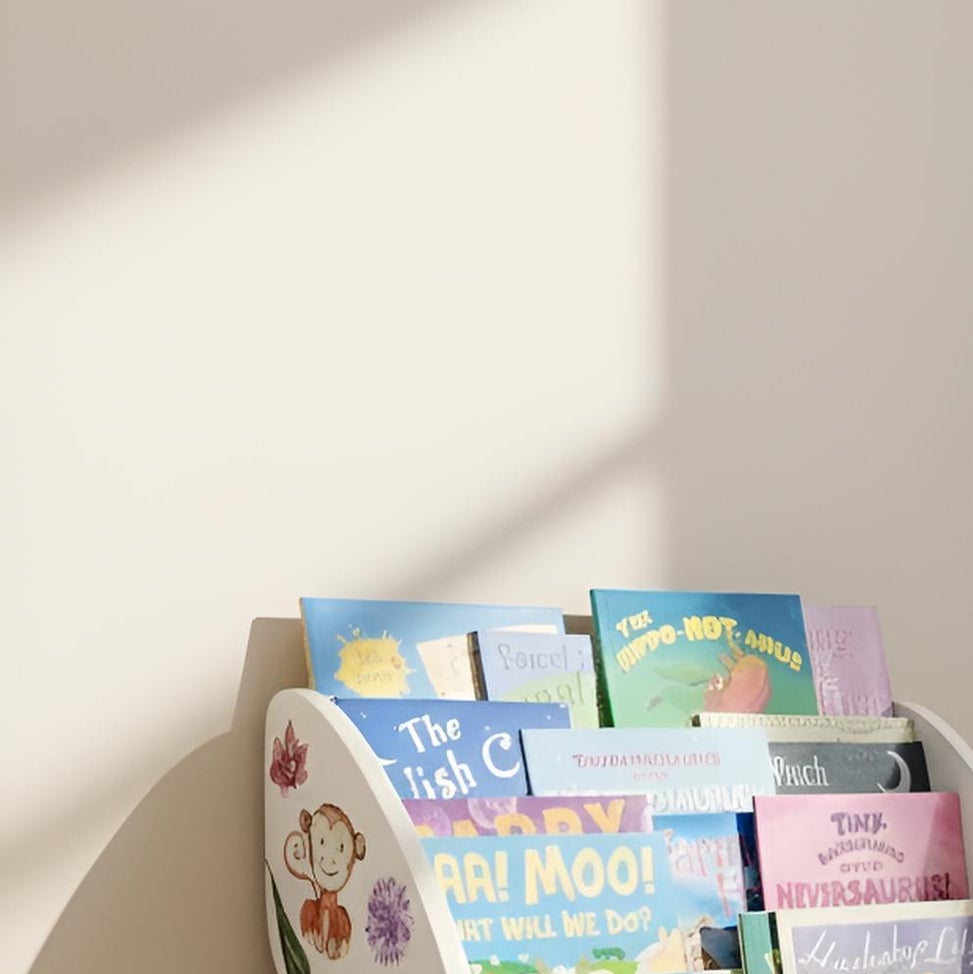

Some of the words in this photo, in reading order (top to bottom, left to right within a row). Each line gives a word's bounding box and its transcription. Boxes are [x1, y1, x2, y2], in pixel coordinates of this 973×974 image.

[398, 714, 461, 753] The
[524, 845, 656, 905] MOO!
[500, 914, 557, 942] WILL
[562, 910, 601, 938] WE
[605, 905, 651, 933] DO?
